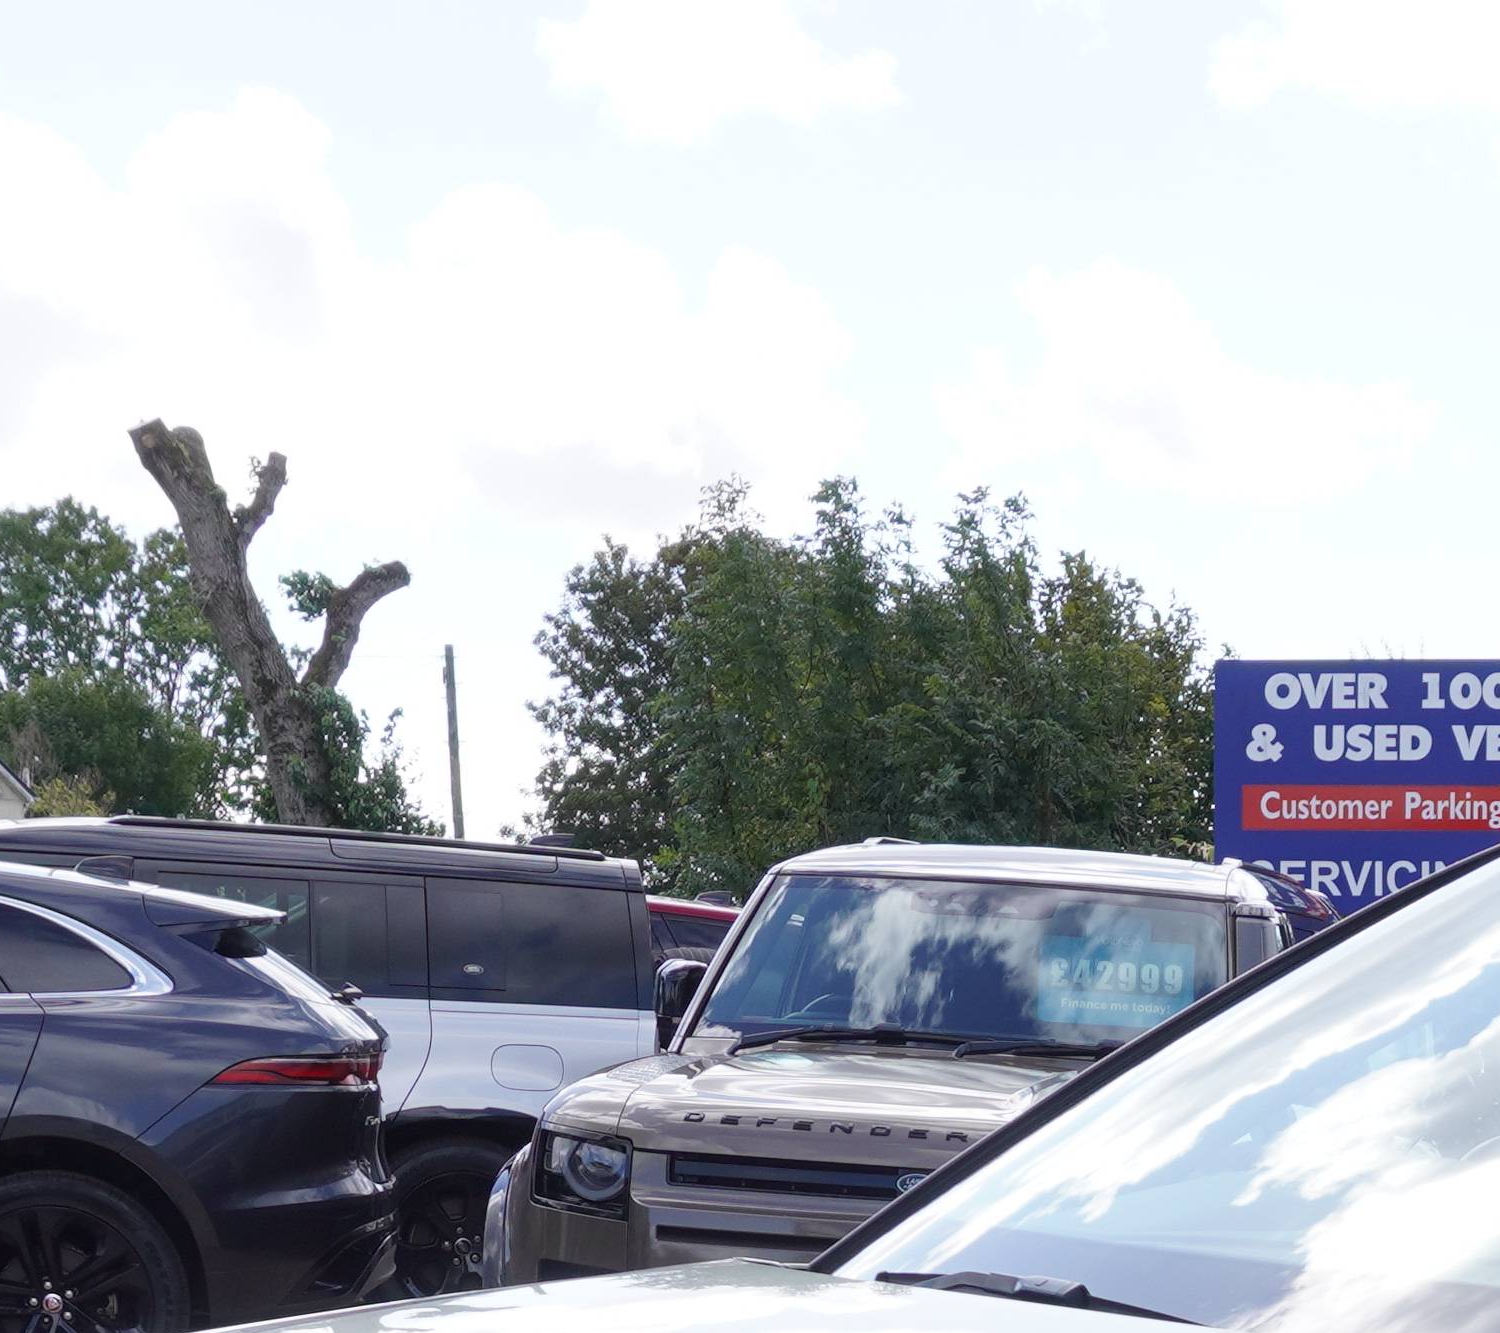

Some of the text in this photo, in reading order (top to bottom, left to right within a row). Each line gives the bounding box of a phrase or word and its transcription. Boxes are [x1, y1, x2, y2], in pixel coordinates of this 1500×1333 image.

[1264, 672, 1389, 710] OVER
[1246, 723, 1284, 762] &
[1313, 724, 1433, 762] USED
[1260, 791, 1393, 820] Customer
[1051, 958, 1183, 995] £42999
[1061, 998, 1106, 1011] Finance
[1110, 1000, 1128, 1011] me
[683, 1111, 969, 1142] DEFENDER
